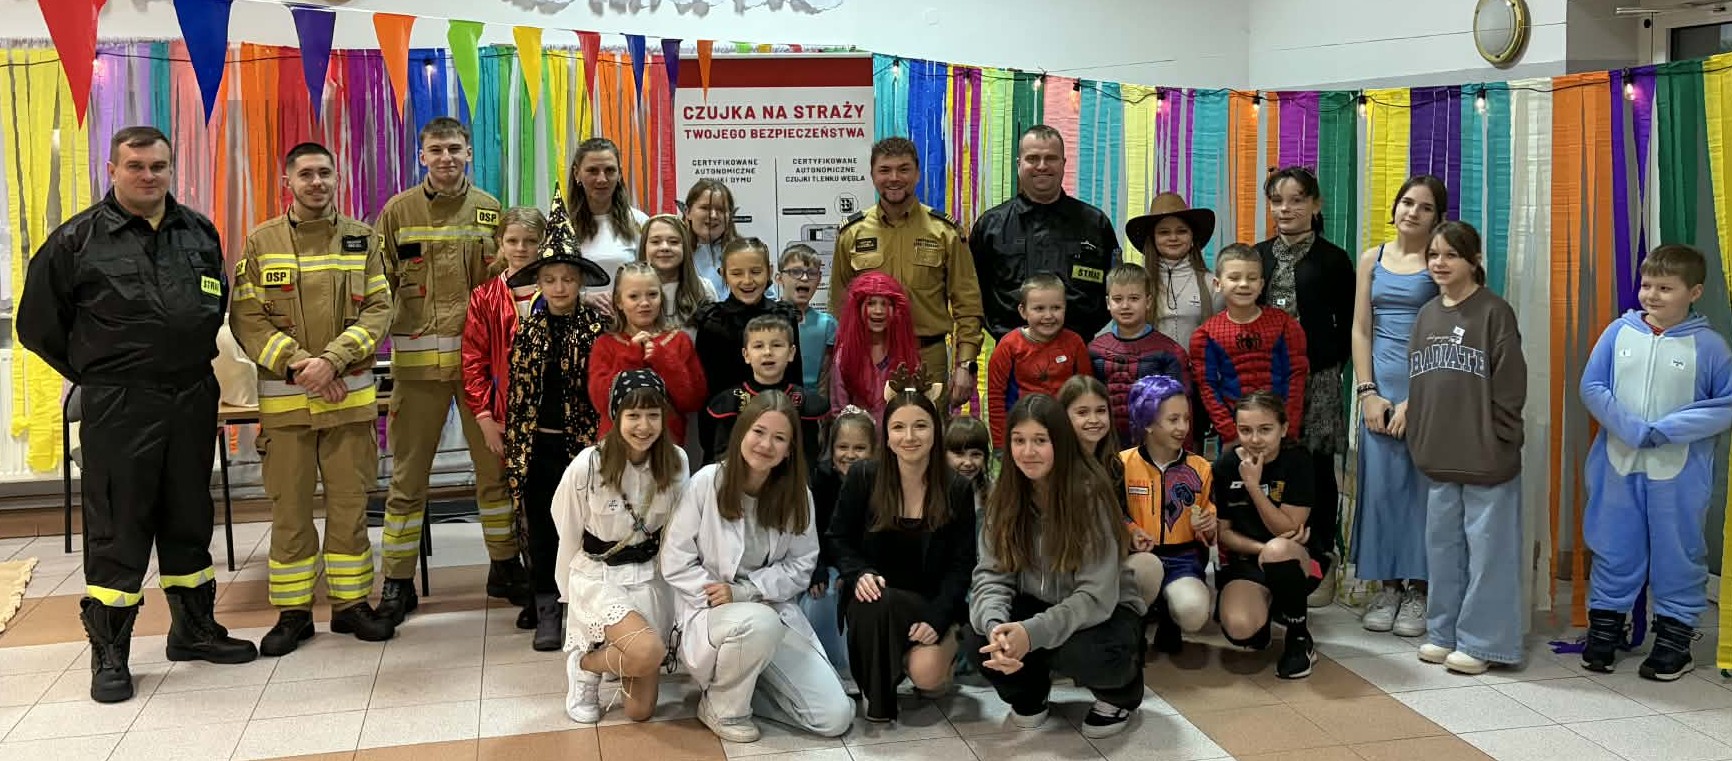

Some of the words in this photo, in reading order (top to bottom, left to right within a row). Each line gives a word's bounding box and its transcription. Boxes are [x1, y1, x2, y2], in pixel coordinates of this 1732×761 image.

[683, 105, 756, 120] CZUJKA
[763, 105, 788, 120] NA
[793, 101, 865, 120] STRAŻY
[684, 128, 747, 140] TWOJEGO
[750, 125, 865, 140] BEZPIECZEŃSTWA
[692, 158, 759, 167] CERTYFIKOWANE
[792, 157, 858, 166] CERTYFIKOWANE
[795, 166, 856, 174] AUTONOMICZNE
[730, 176, 752, 184] DYMU
[785, 175, 811, 183] CZUJKI
[812, 175, 840, 183] TLENKU
[479, 211, 497, 223] OSP
[265, 271, 287, 283] OSP
